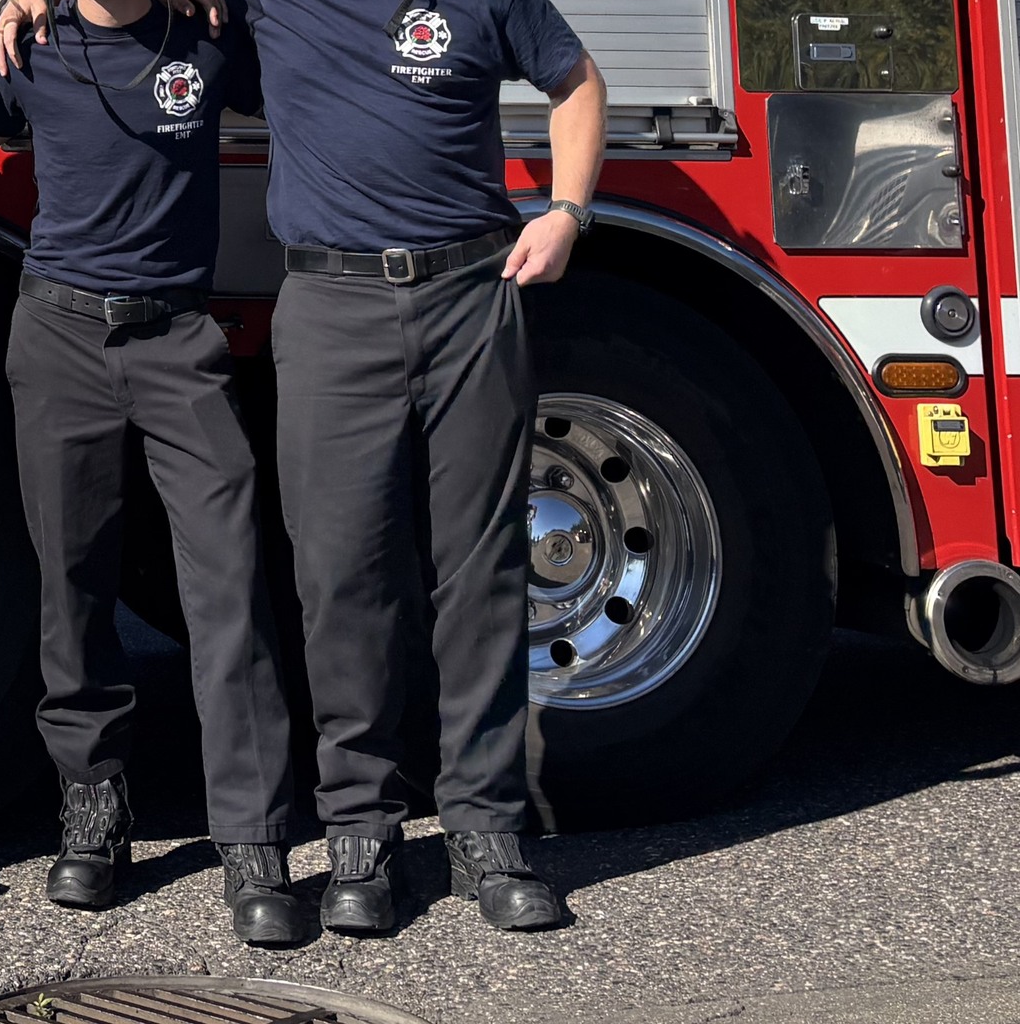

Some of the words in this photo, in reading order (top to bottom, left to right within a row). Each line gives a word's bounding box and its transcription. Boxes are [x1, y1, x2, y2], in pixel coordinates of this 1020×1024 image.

[391, 65, 452, 76] FIREFIGHTER
[411, 75, 432, 84] EMT
[175, 130, 191, 140] EMT
